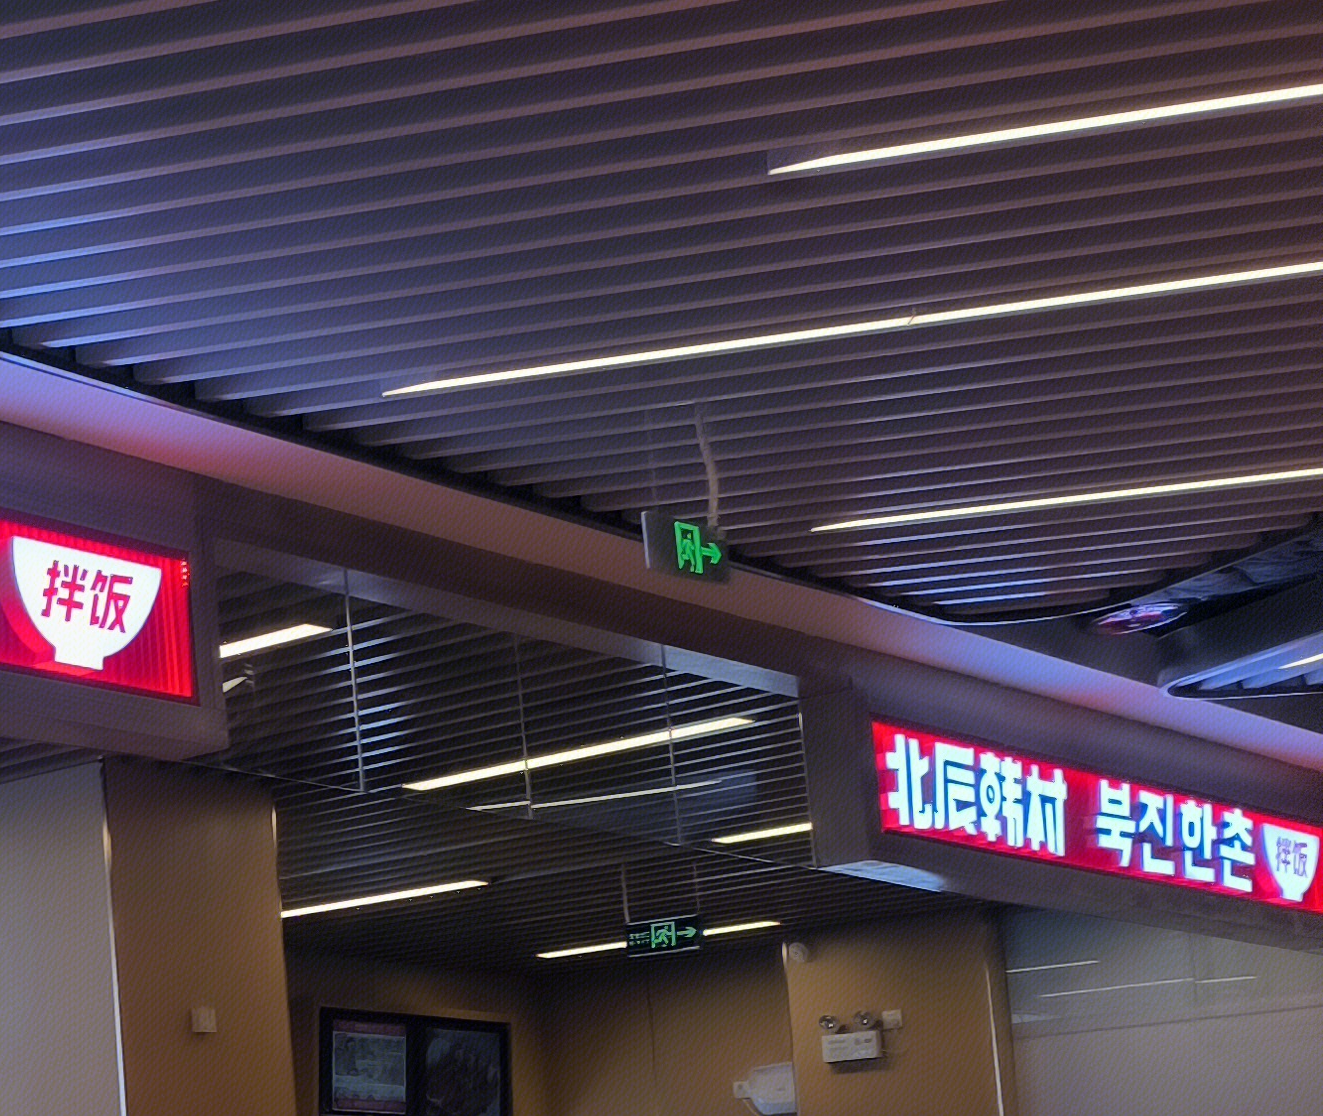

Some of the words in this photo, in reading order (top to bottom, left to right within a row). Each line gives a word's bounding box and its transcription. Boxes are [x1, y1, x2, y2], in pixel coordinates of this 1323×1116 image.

[43, 557, 135, 634] 拌饭
[885, 734, 1068, 856] 北辰韩村
[1095, 779, 1256, 892] 북진한촌
